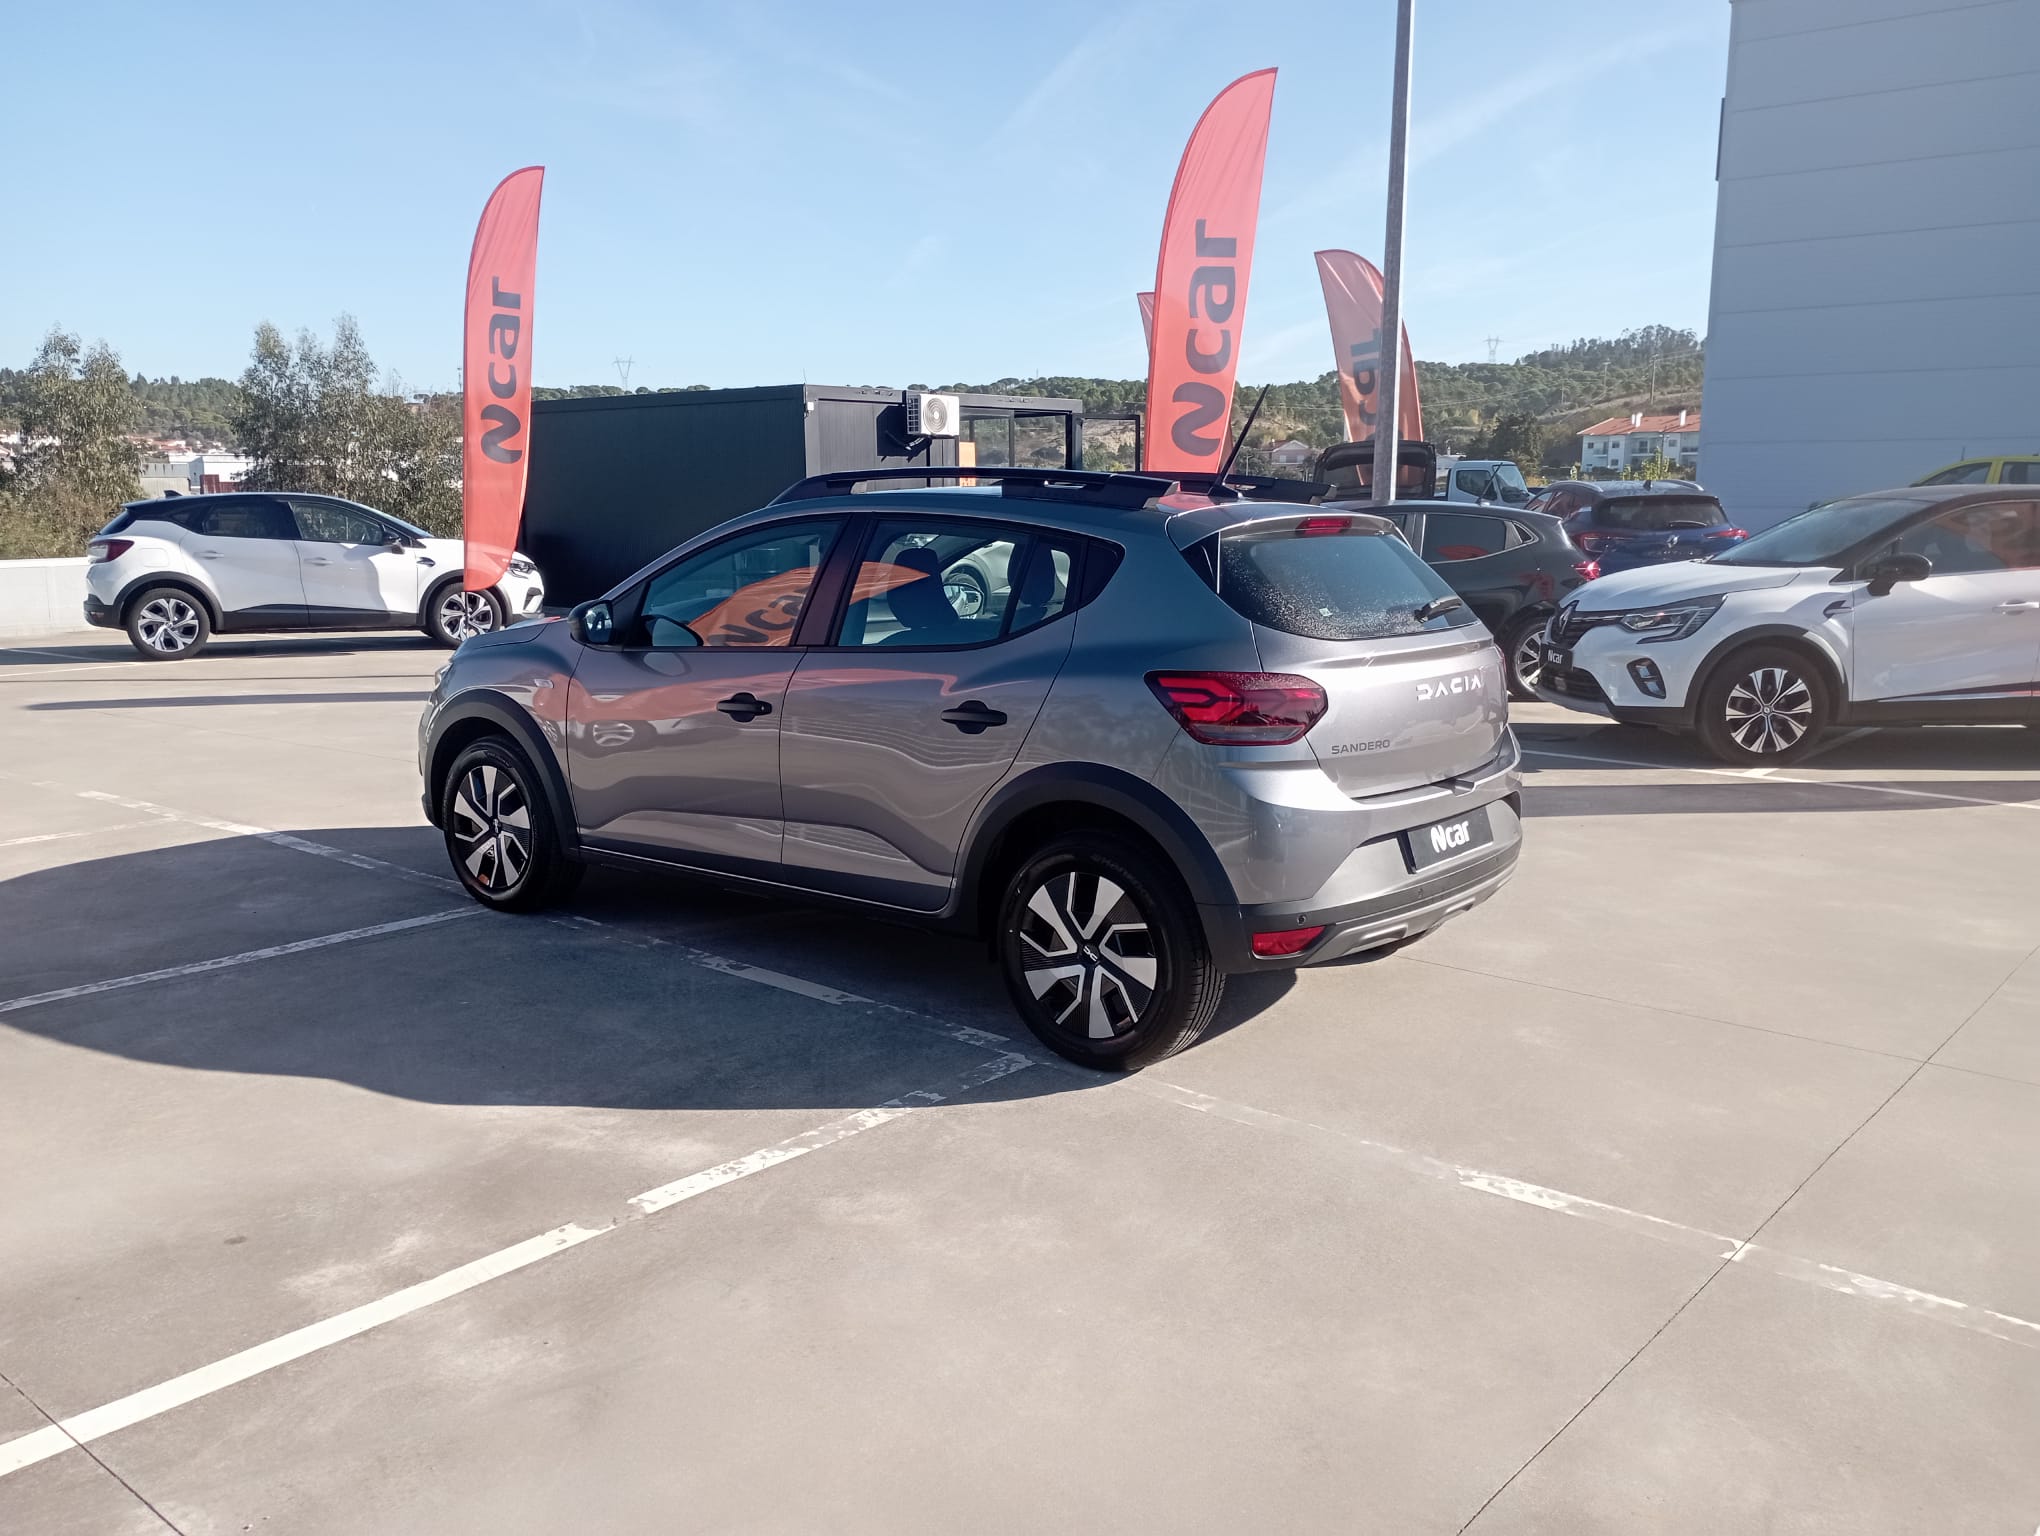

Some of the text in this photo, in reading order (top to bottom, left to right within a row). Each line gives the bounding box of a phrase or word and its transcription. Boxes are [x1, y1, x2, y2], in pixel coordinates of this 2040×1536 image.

[1171, 219, 1237, 457] Ncar
[480, 276, 522, 464] Ncar
[1547, 649, 1564, 664] Ncar
[1416, 674, 1482, 701] DACIA
[1331, 739, 1391, 755] SANDERO
[1430, 820, 1470, 853] Ncar
